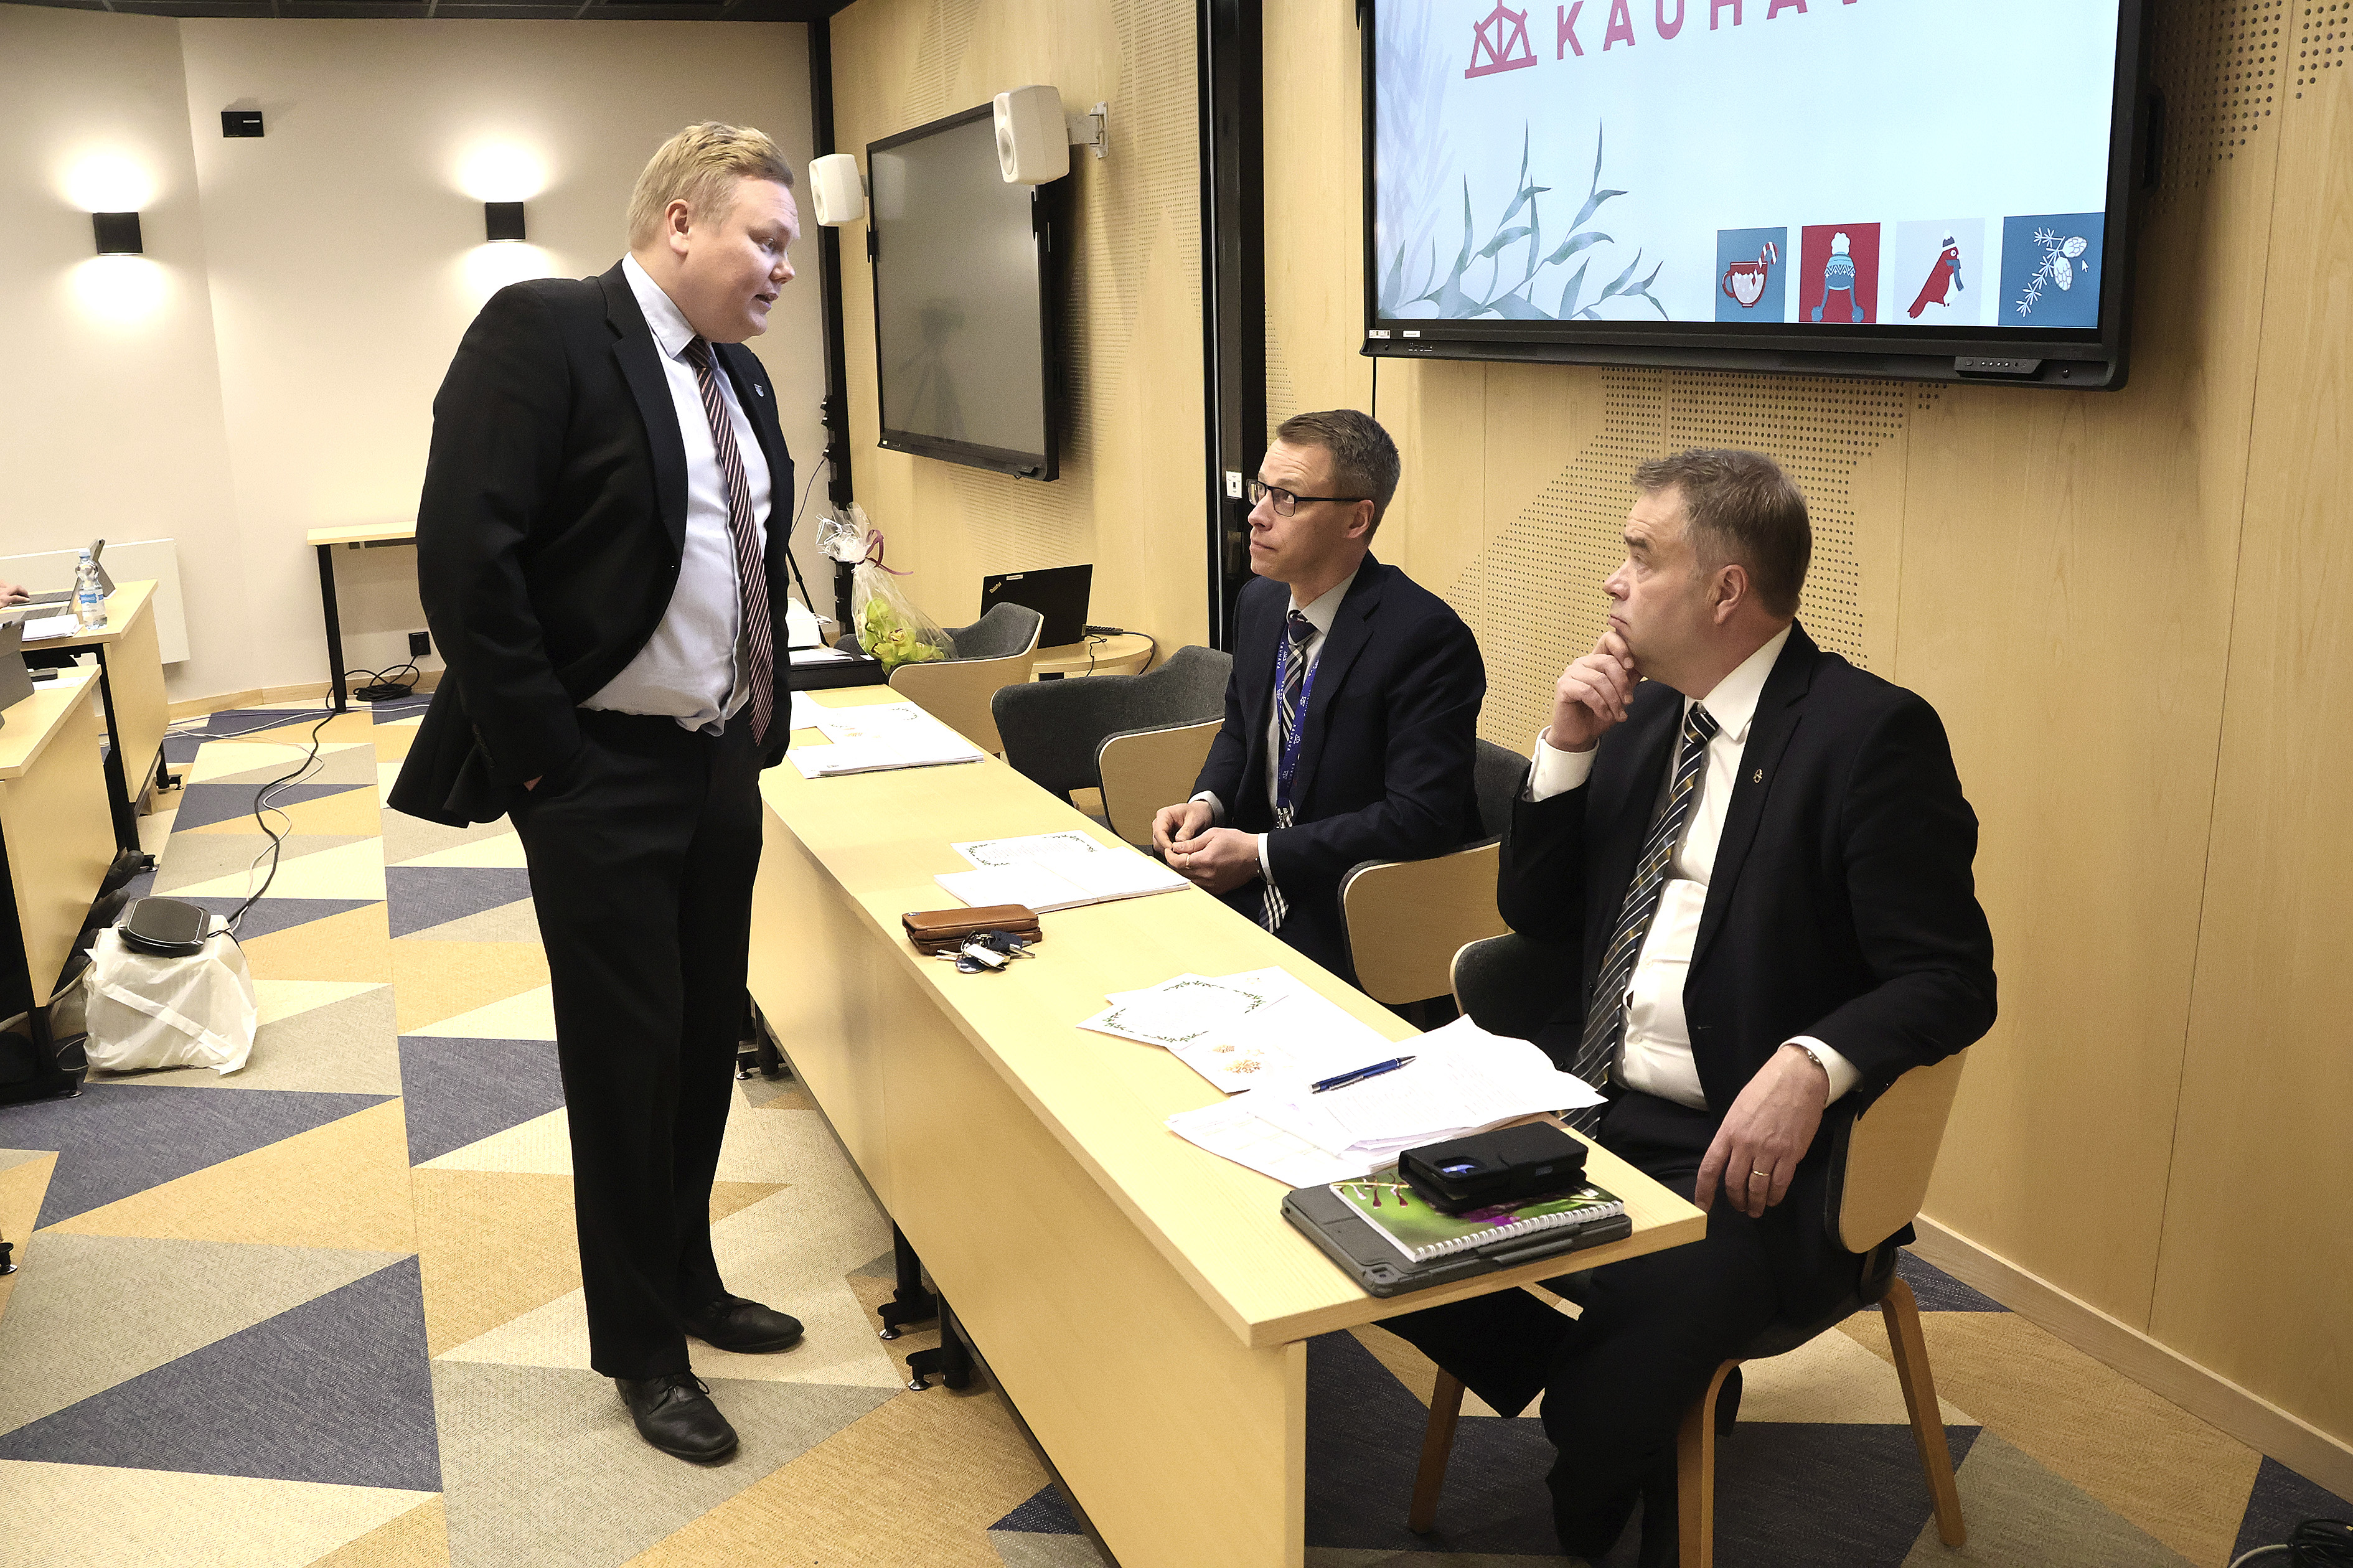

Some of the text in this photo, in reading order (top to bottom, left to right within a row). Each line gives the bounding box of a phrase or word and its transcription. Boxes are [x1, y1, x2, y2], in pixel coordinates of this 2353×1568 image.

[1557, 0, 1858, 60] KAUH
[1277, 641, 1285, 669] KAUHAVA
[1287, 724, 1297, 751] KAUHAVA
